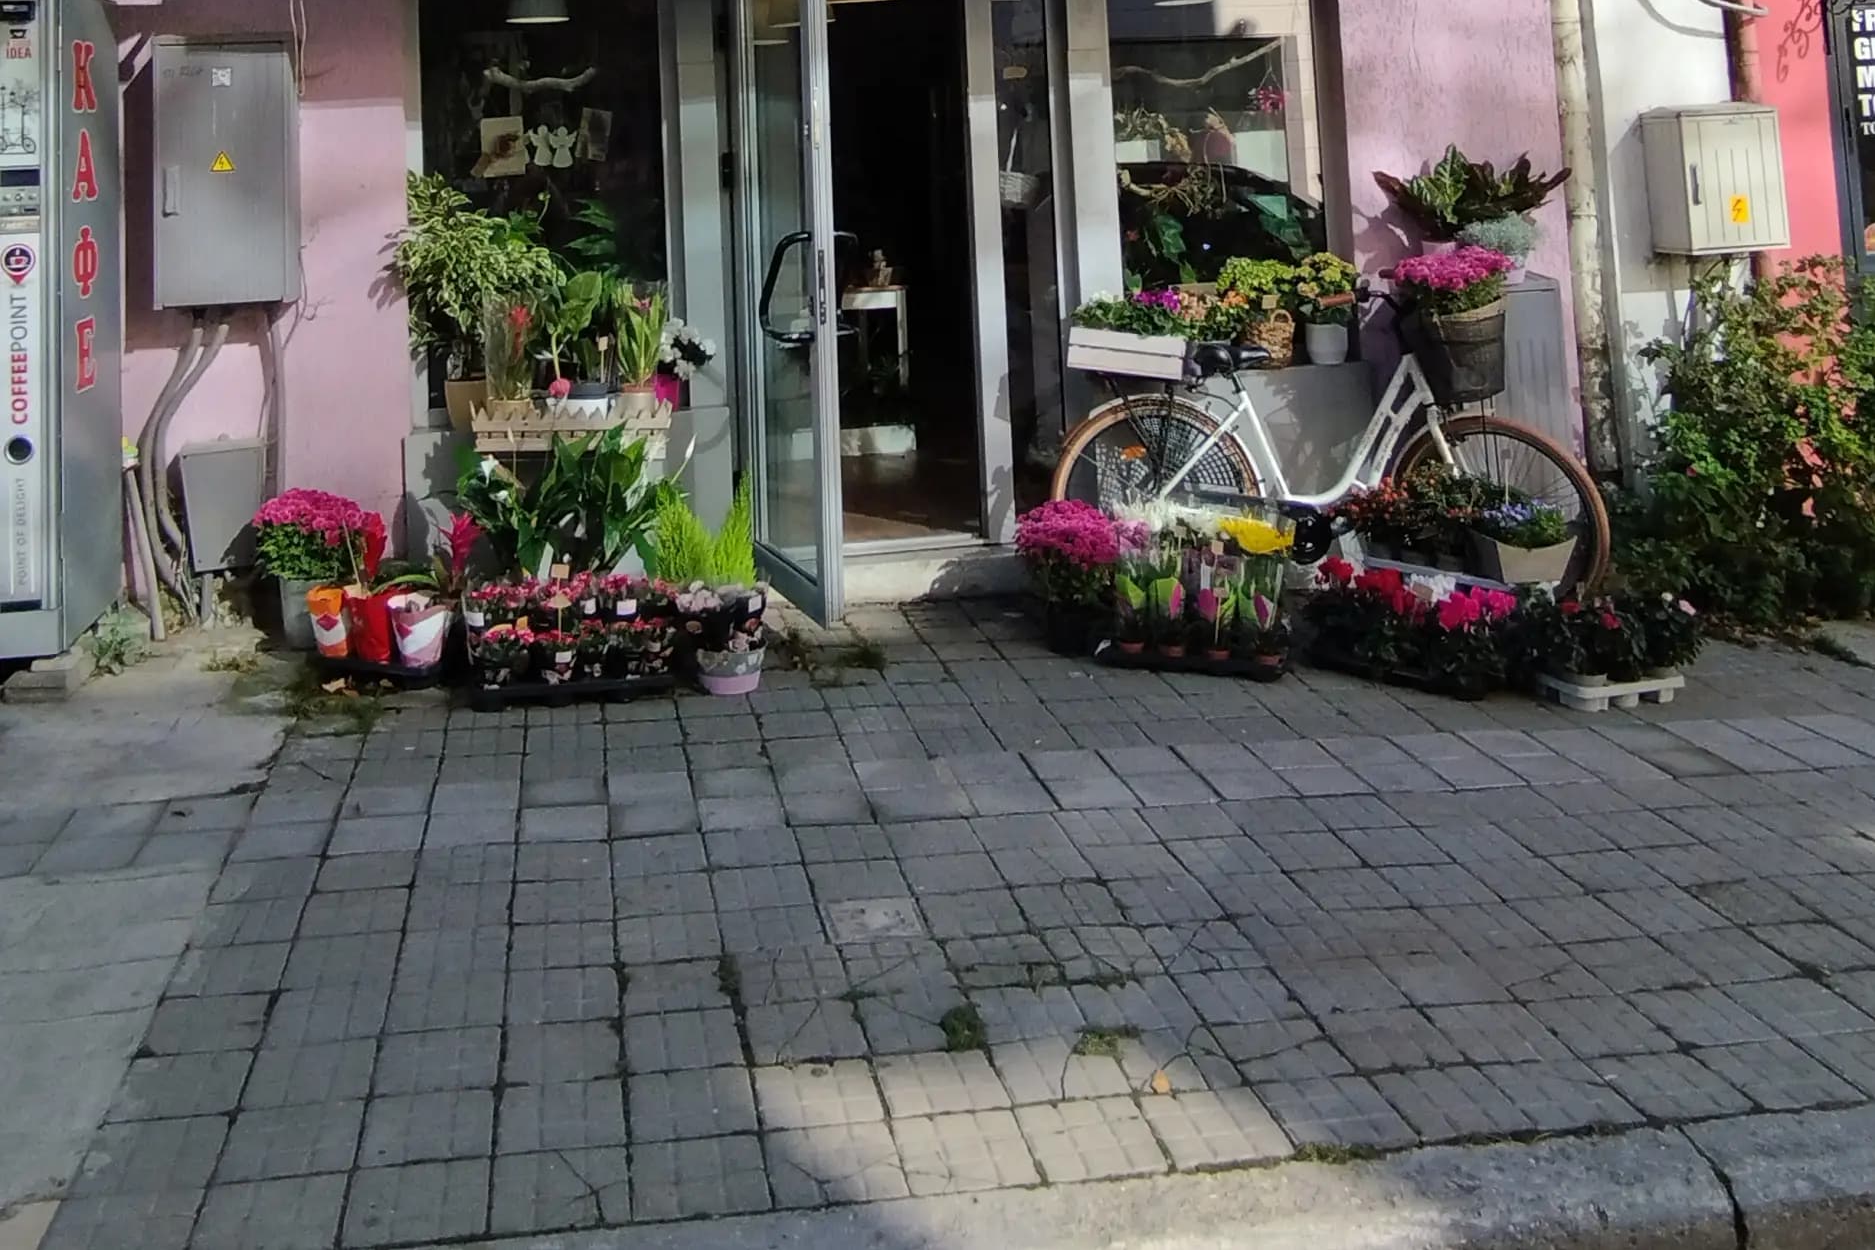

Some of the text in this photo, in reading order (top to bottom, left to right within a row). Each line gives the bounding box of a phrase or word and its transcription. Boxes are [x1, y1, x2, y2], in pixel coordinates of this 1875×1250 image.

[6, 47, 32, 59] IDEA
[1858, 94, 1875, 117] T
[72, 40, 98, 393] КАФЕ
[15, 477, 26, 526] DELIGHT
[16, 531, 26, 546] OF
